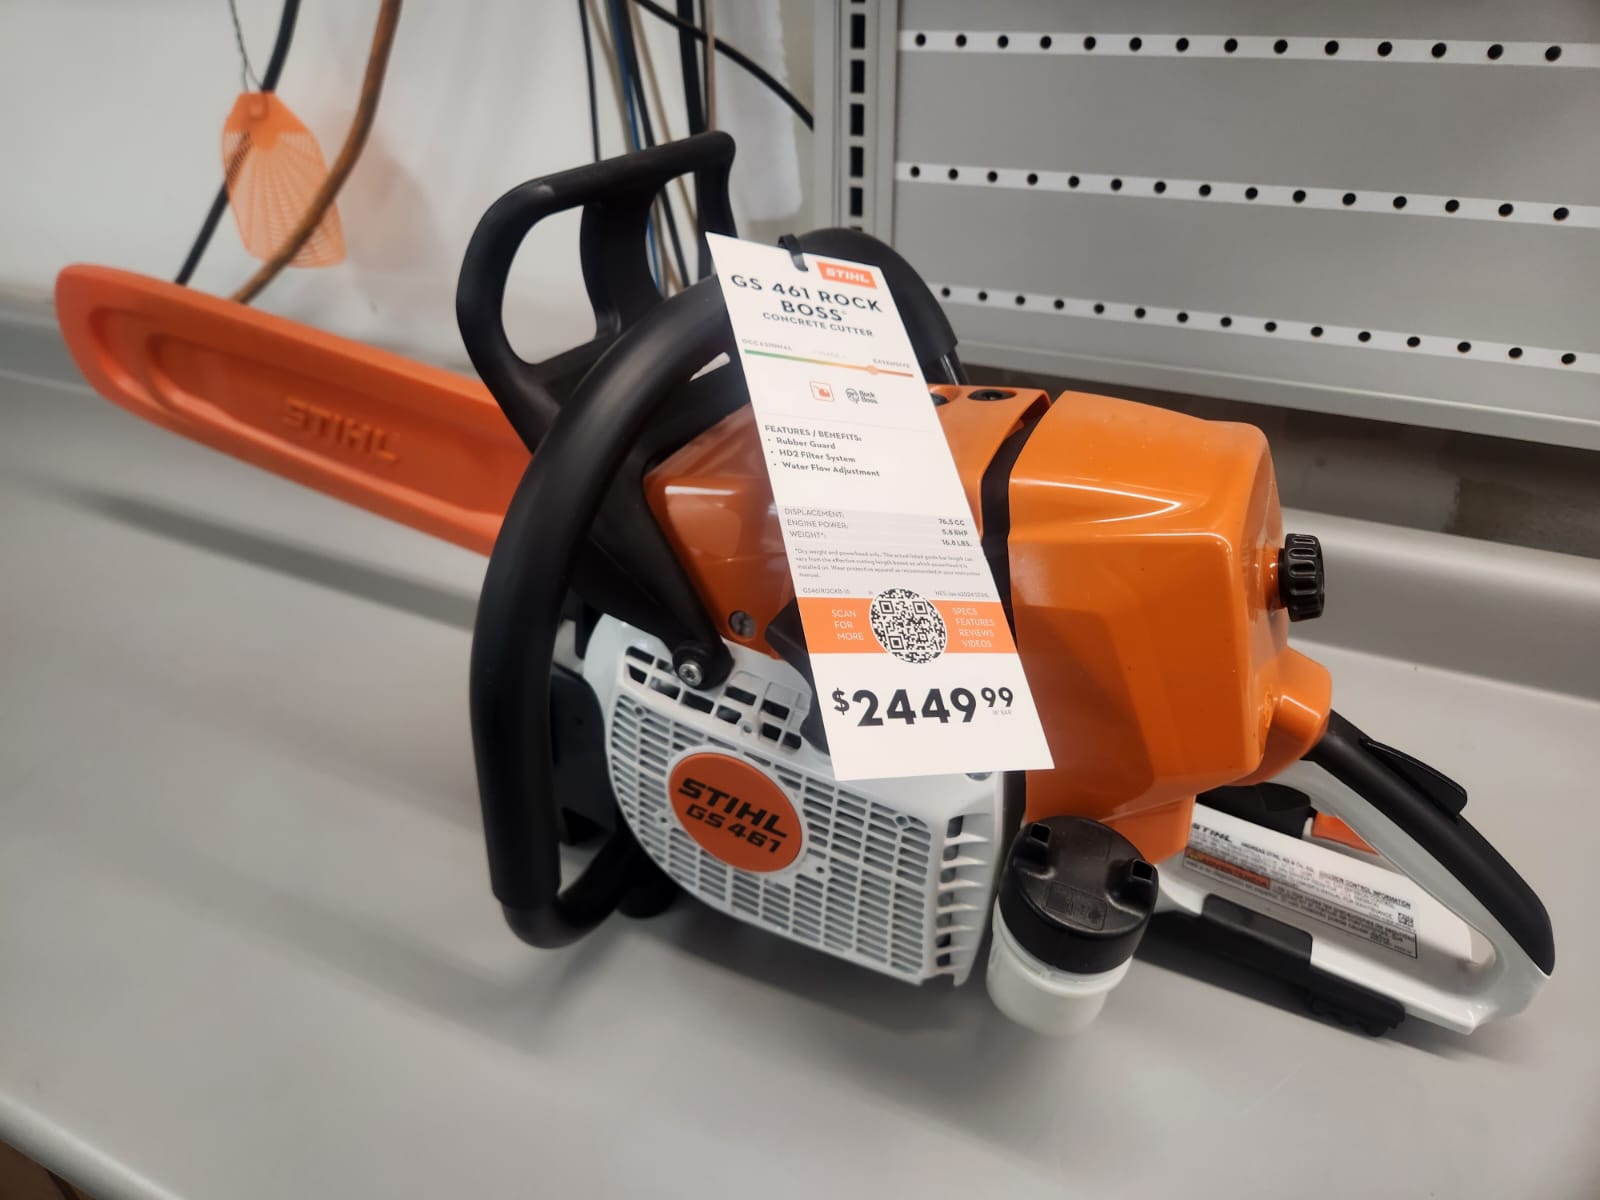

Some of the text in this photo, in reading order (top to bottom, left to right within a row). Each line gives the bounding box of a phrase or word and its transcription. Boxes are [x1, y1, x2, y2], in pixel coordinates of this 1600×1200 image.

[825, 267, 870, 283] STIHL
[731, 275, 883, 312] GS 461 ROCK
[763, 312, 873, 336] CONCRETE CUTTER
[282, 396, 396, 460] STIHL
[765, 425, 811, 436] FEATURES
[818, 430, 862, 441] BENEFITS:
[776, 437, 836, 449] Rubber Guard
[779, 449, 856, 463] HD2 Filter System
[782, 461, 880, 476] Water Flow Adjustment
[784, 508, 845, 518] DISPLACEMENT:
[787, 519, 817, 528] ENGINE
[818, 521, 848, 529] POWER:
[831, 609, 857, 618] SCAN
[952, 607, 978, 616] SPECS
[834, 621, 853, 629] FOR
[955, 618, 995, 627] FEATURES
[837, 632, 864, 641] MORE
[959, 629, 994, 638] REVIEWS
[962, 639, 992, 648] VIDEOS
[678, 777, 787, 838] STIHL
[686, 804, 781, 853] GS 461
[1192, 822, 1233, 844] STIHL
